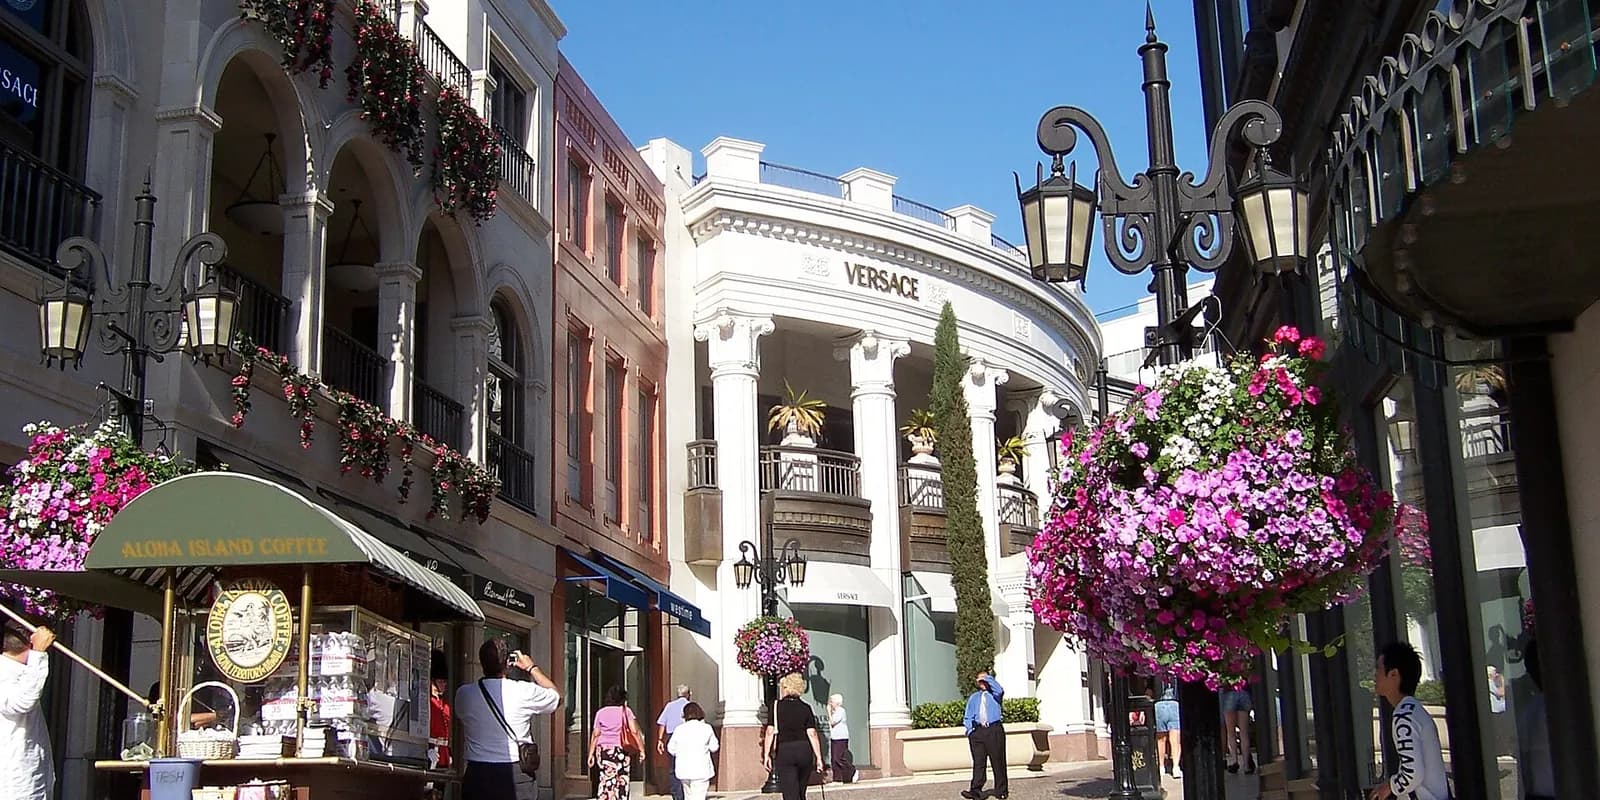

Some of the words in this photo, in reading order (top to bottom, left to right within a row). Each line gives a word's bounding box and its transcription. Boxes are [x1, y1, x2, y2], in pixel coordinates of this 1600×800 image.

[844, 261, 920, 301] VERSACE
[122, 540, 183, 558] ALOHA
[189, 538, 253, 557] ISLAND
[259, 537, 328, 555] COFFEE
[209, 600, 229, 648] ALOHA
[270, 593, 290, 647] COFFEE
